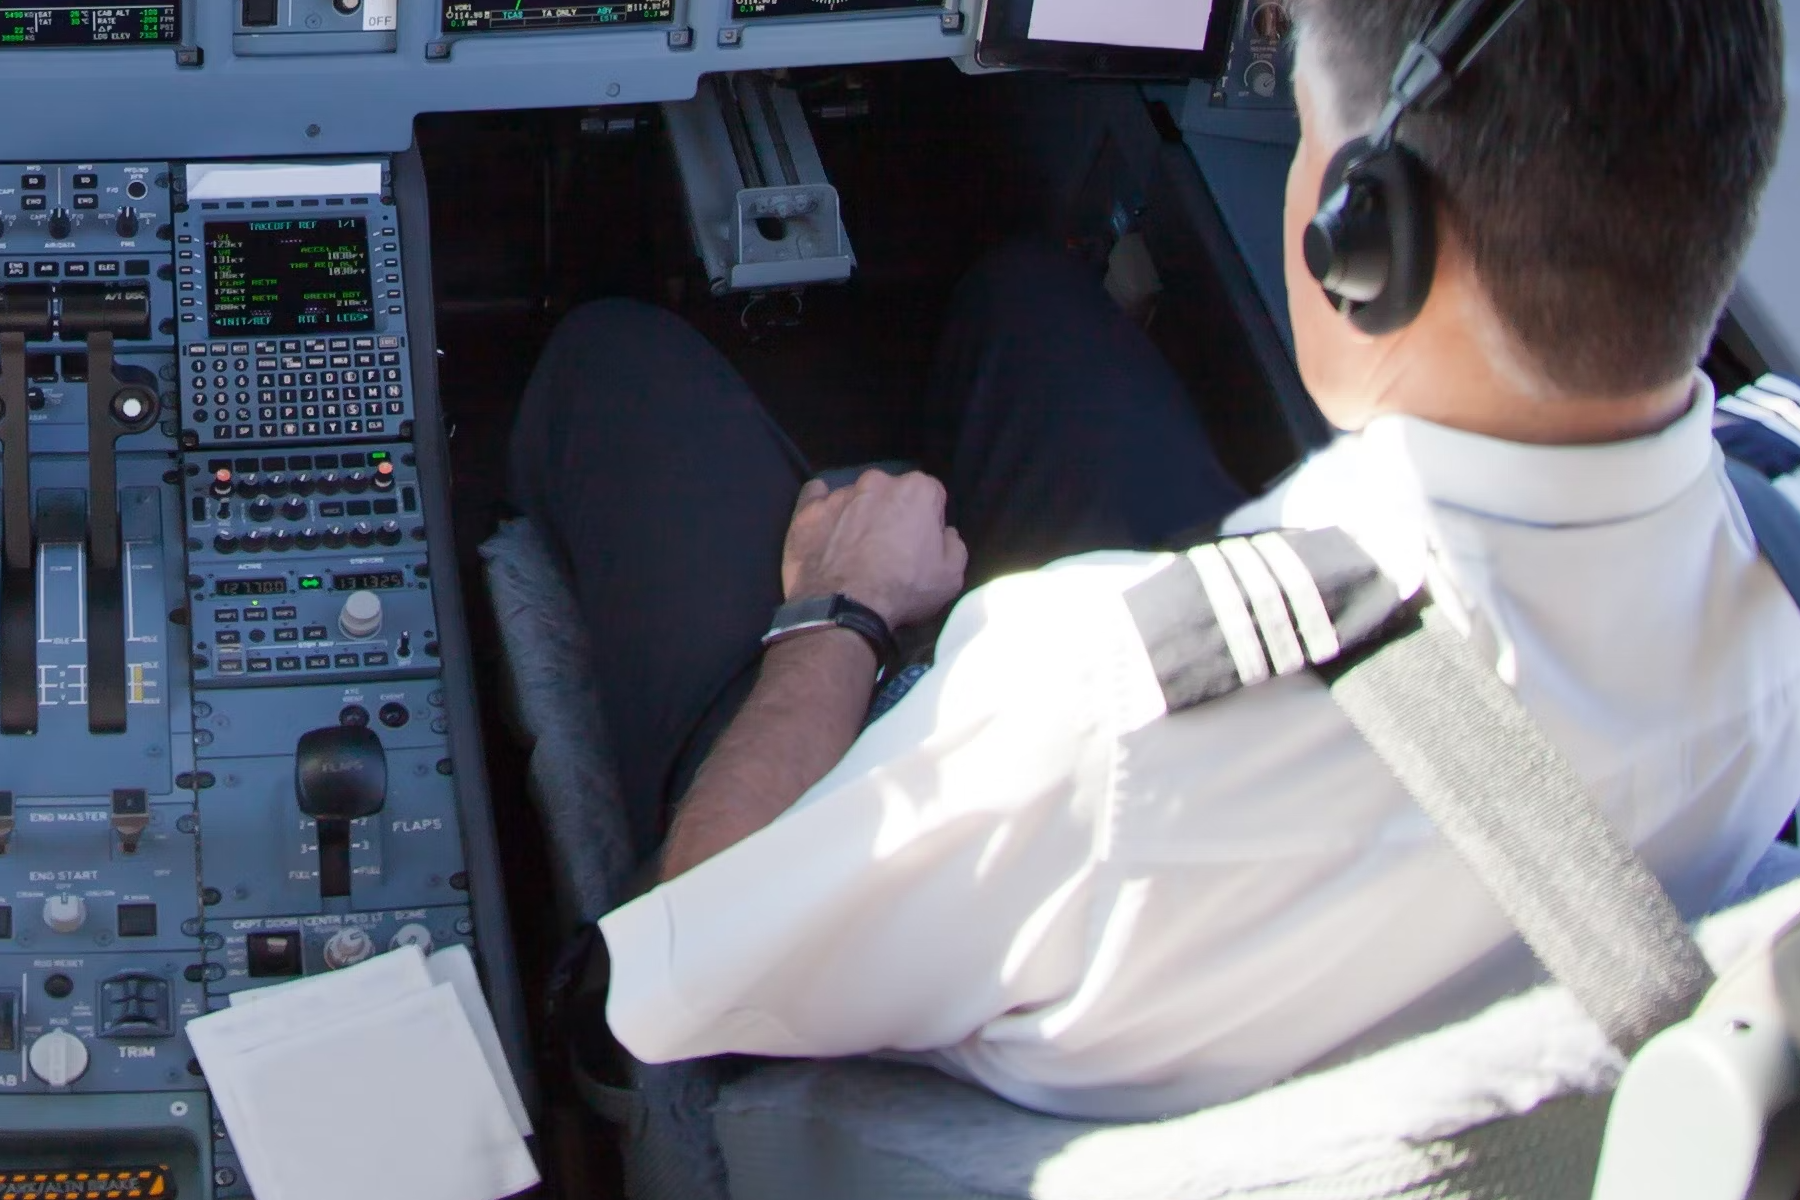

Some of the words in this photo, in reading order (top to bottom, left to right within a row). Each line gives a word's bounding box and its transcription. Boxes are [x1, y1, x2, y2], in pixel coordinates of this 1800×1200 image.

[369, 16, 392, 26] OFF
[30, 813, 54, 822] ENG
[57, 812, 107, 821] MASTER
[392, 819, 442, 832] FLAPS
[29, 871, 55, 880] ENG
[58, 871, 98, 880] START
[118, 1047, 156, 1058] TRIM
